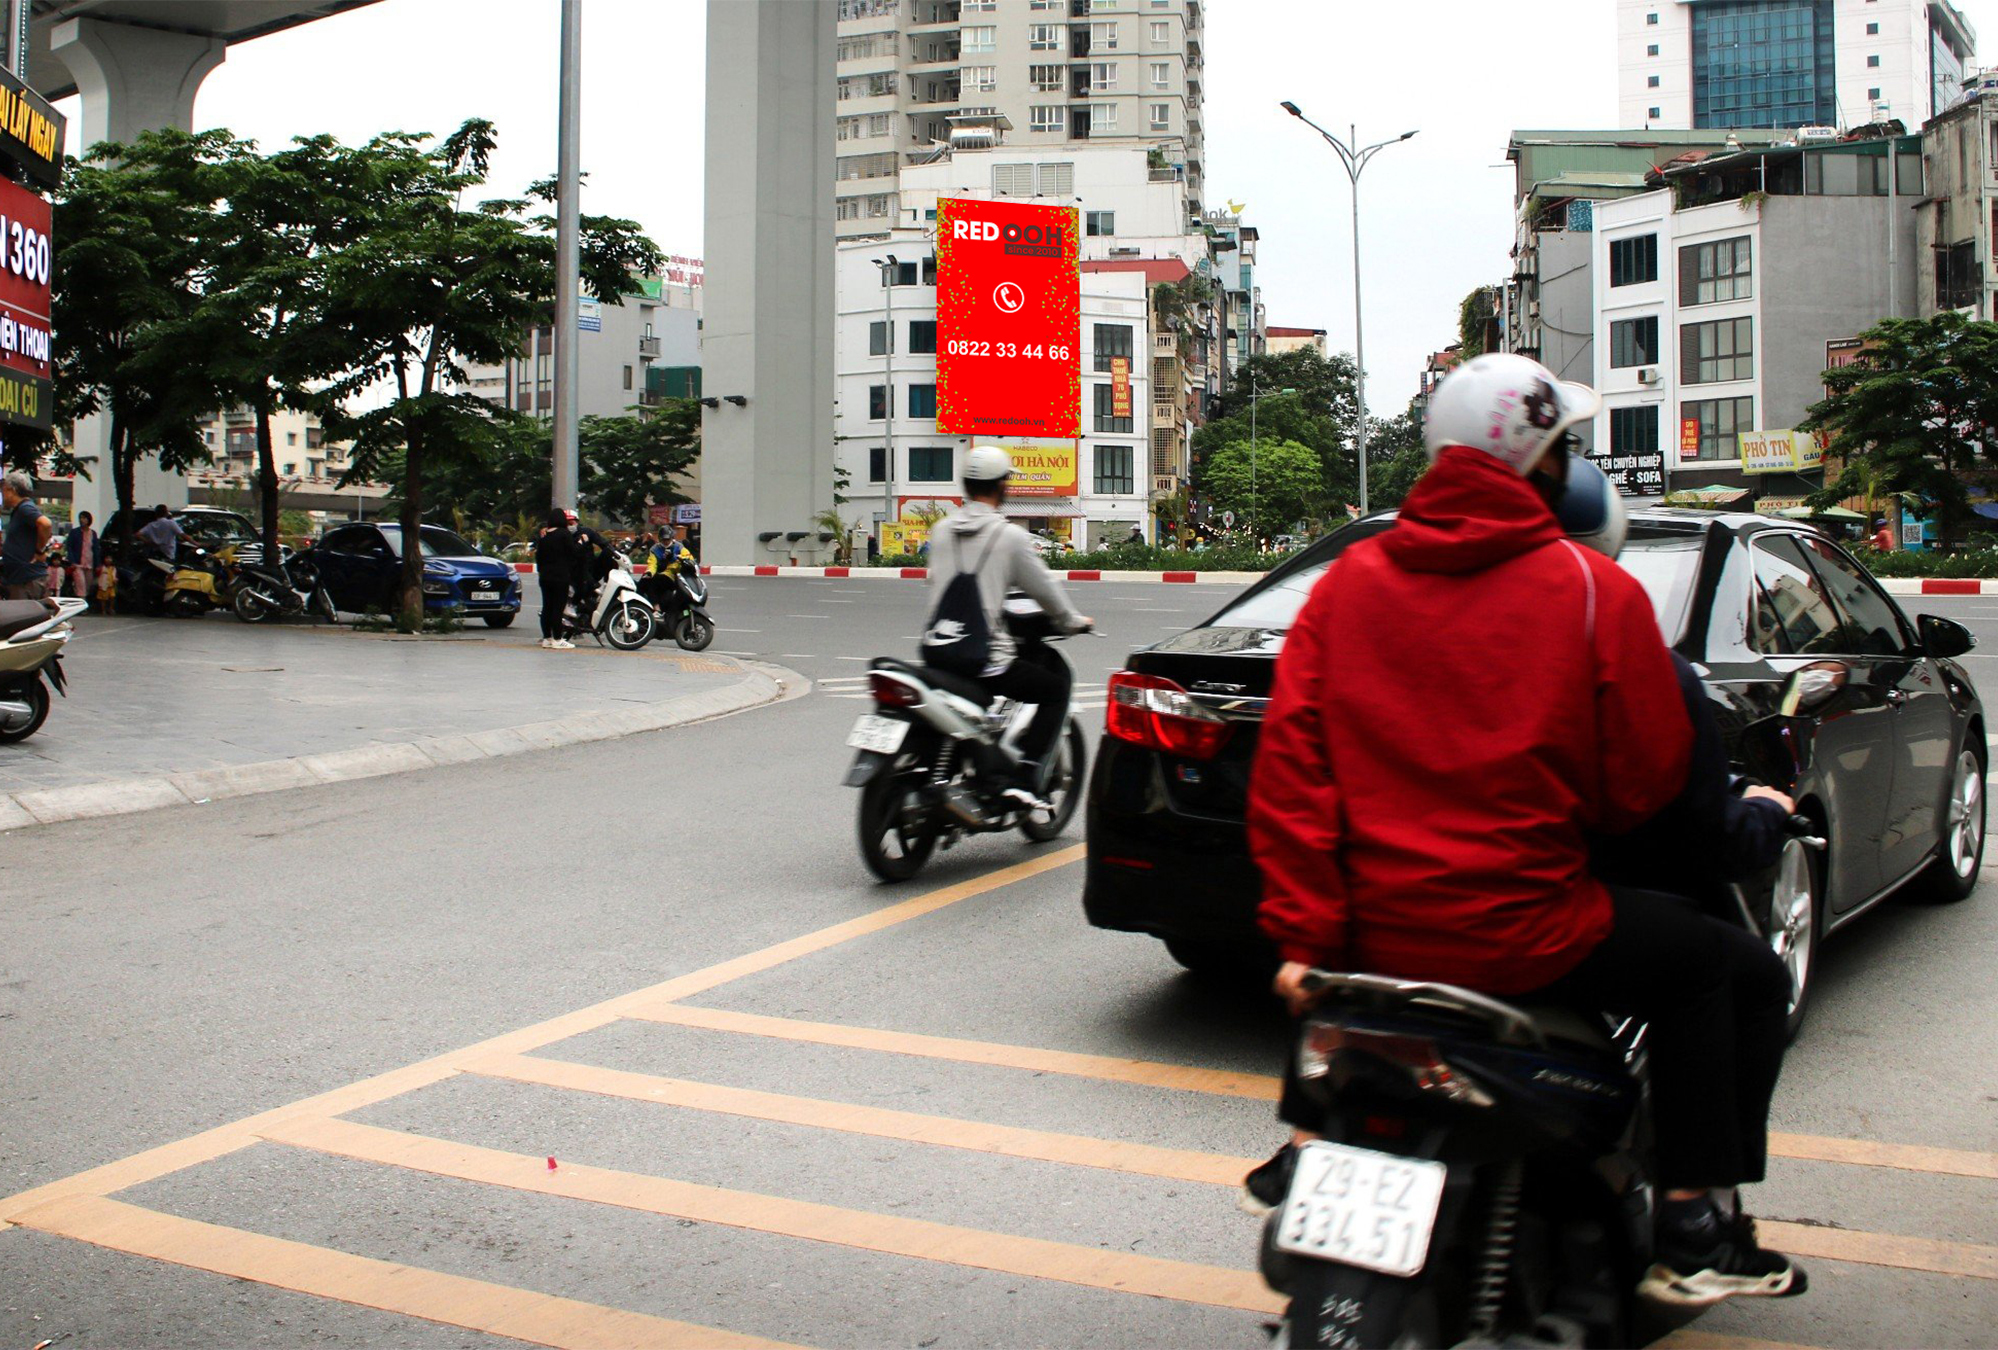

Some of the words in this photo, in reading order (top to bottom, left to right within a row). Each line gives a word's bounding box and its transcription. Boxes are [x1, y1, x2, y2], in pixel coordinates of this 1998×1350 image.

[9, 88, 31, 144] LẤY
[28, 109, 57, 162] NGAY
[953, 219, 999, 241] RED
[1002, 223, 1062, 246] OOH
[10, 216, 49, 286] 360
[1008, 245, 1034, 256] since
[1036, 247, 1059, 257] 2010
[19, 323, 48, 369] THOẠI
[948, 340, 990, 356] 0822
[996, 343, 1017, 358] 33
[1022, 344, 1044, 359] 44
[1049, 346, 1070, 360] 66
[22, 379, 38, 418] CŨ
[973, 416, 1045, 427] www.redooh.vn
[1743, 434, 1768, 458] PHỞ
[1027, 453, 1045, 468] HÀ
[1047, 454, 1070, 471] NỘI
[1613, 454, 1637, 469] CHUYÊN
[1638, 452, 1661, 470] NGHIỆP
[1608, 469, 1628, 484] GHẾ
[1636, 470, 1662, 484] SOFA
